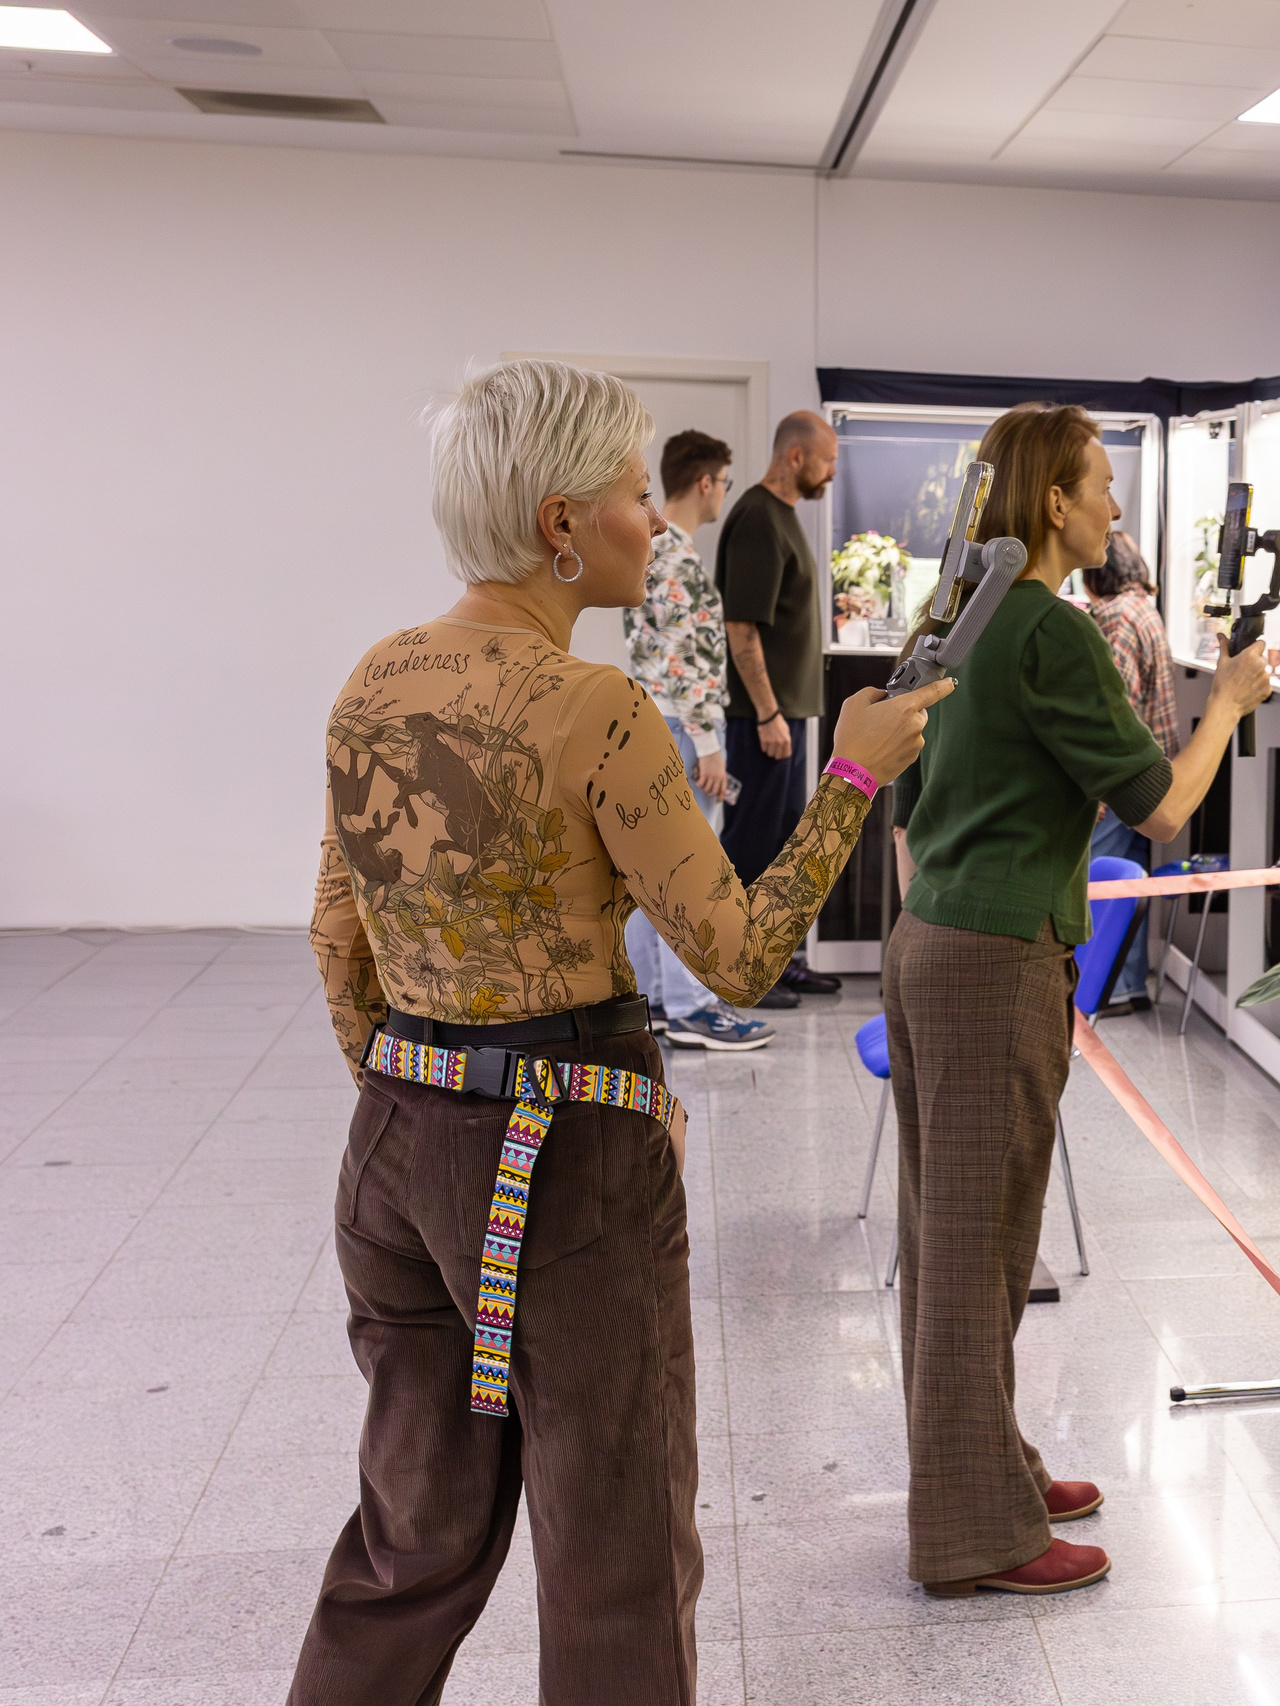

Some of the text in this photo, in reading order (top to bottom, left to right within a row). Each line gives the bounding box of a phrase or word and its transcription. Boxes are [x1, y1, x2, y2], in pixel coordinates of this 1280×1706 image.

[363, 649, 471, 687] tenderness
[615, 743, 685, 831] be gentl
